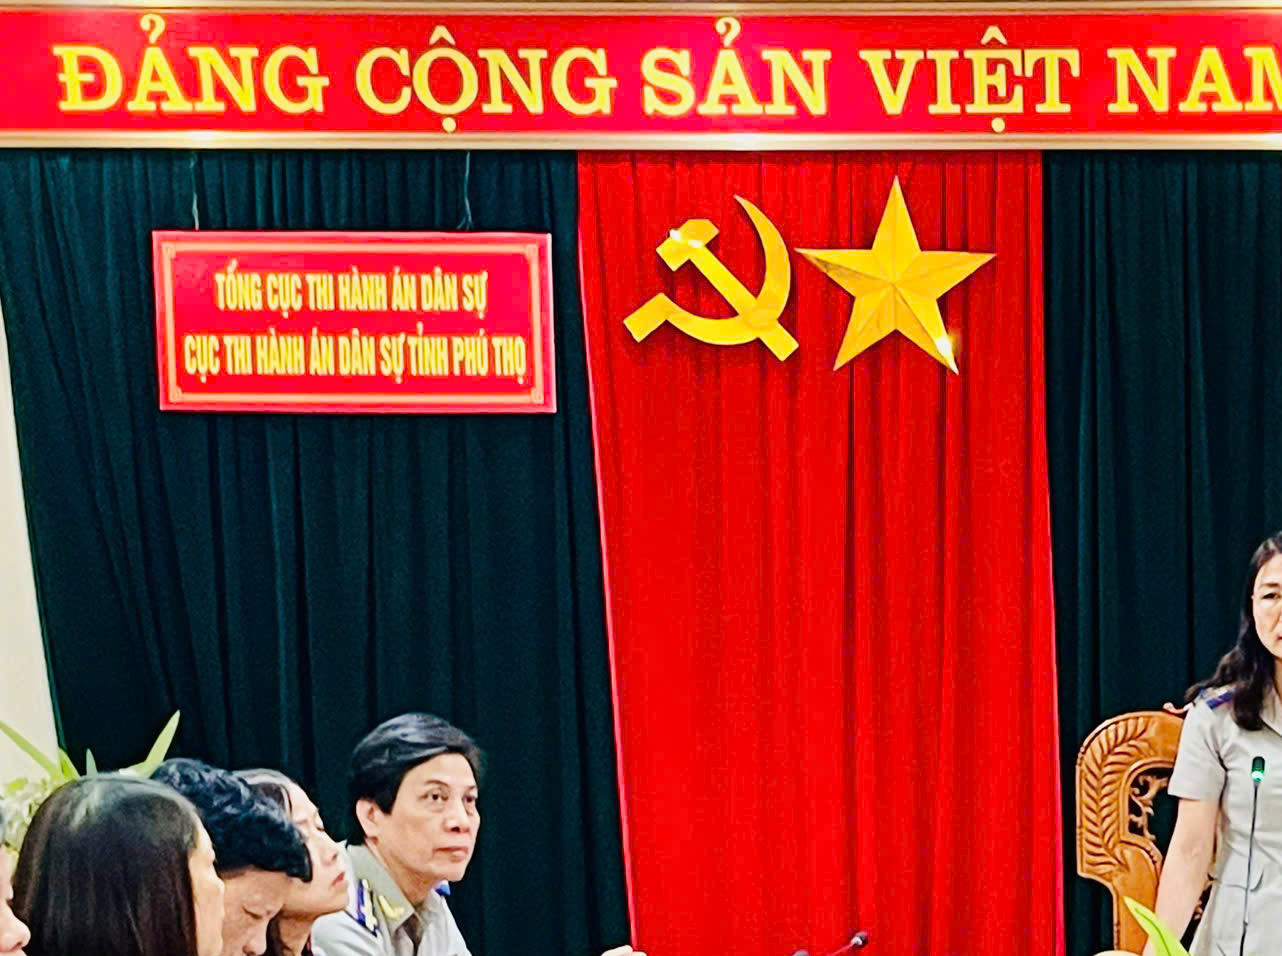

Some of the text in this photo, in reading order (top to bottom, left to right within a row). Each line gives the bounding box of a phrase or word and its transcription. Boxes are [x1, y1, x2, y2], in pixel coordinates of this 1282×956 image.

[54, 13, 329, 113] ĐẢNG
[356, 25, 618, 133] CỘNG
[643, 16, 831, 118] SẢN
[860, 26, 1080, 133] VIỆT
[266, 273, 302, 318] CỤC
[305, 272, 335, 310] THI
[338, 266, 388, 311] HÀNH
[391, 266, 418, 311] ÁN
[421, 267, 459, 311] DÂN
[462, 270, 488, 319] SỰ
[184, 335, 220, 384] CỤC
[224, 335, 253, 375] THI
[256, 327, 305, 375] HÀNH
[309, 327, 335, 375] ÁN
[338, 327, 376, 375] DÂN
[380, 332, 406, 384] SỰ
[452, 328, 489, 376] PHÚ
[492, 335, 526, 385] THỌ
